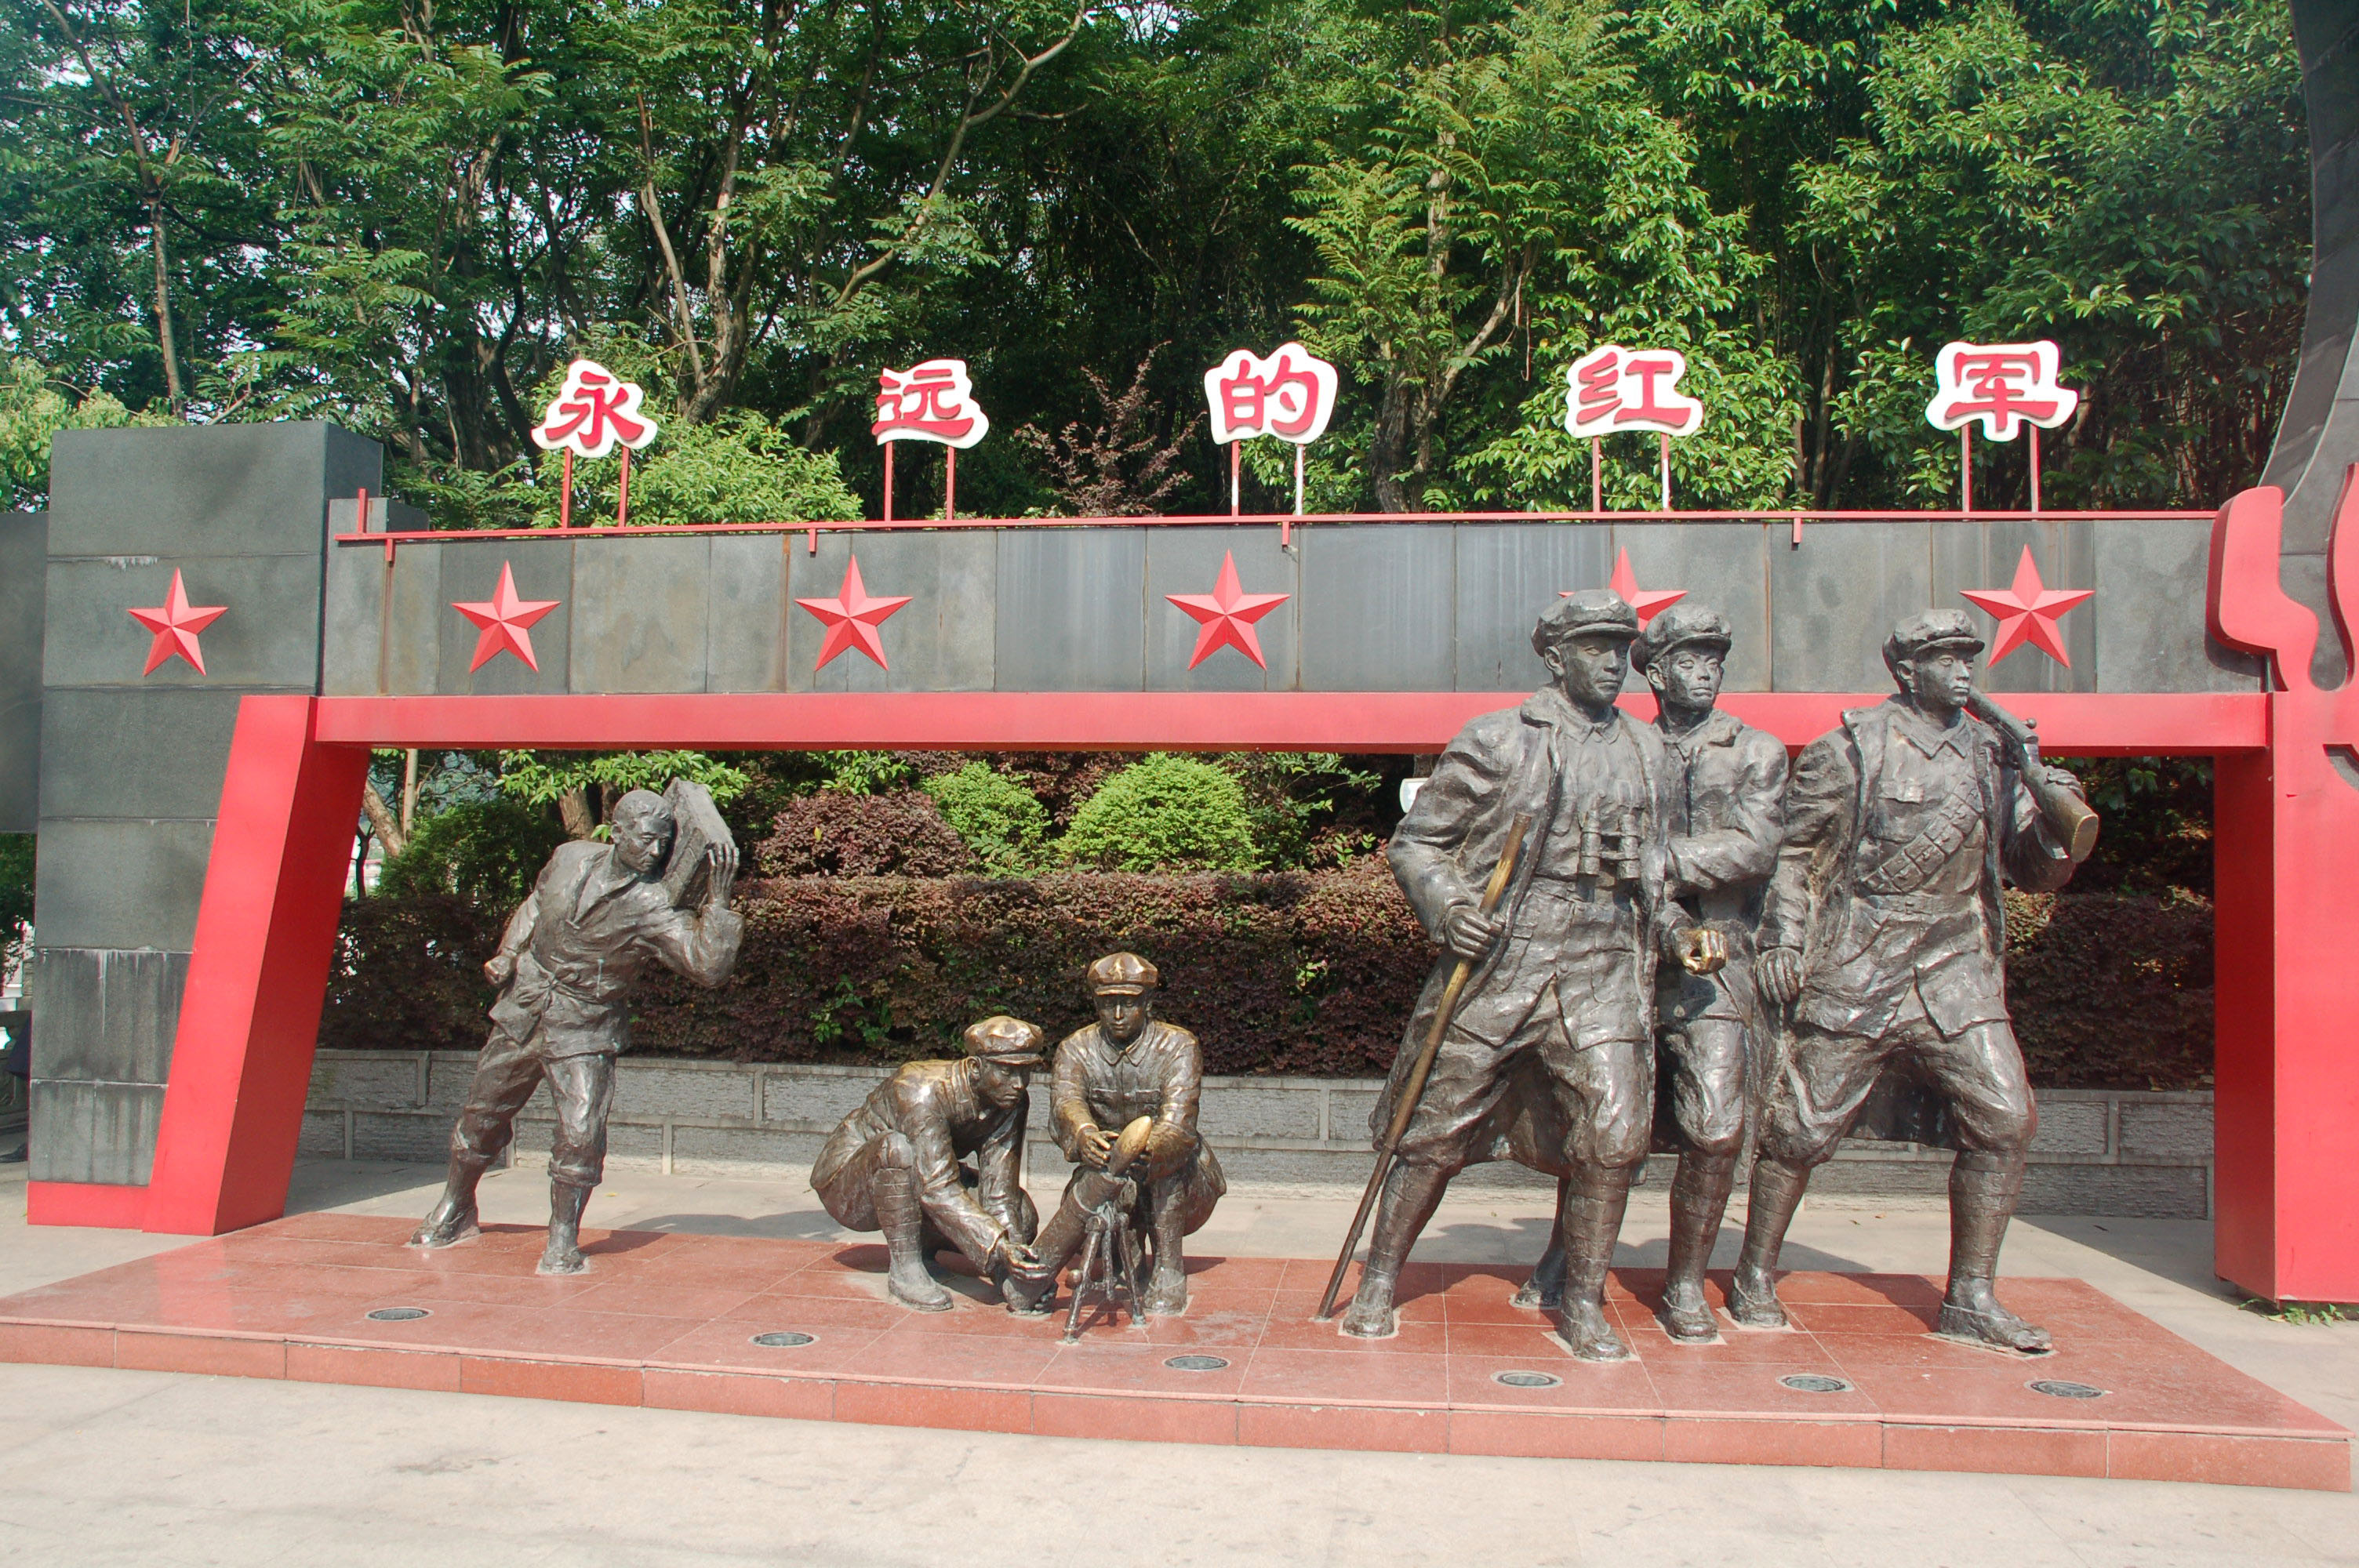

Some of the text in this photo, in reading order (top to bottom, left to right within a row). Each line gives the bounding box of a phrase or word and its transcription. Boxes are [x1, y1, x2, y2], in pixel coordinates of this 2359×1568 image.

[545, 350, 2059, 449] 永远的红军
